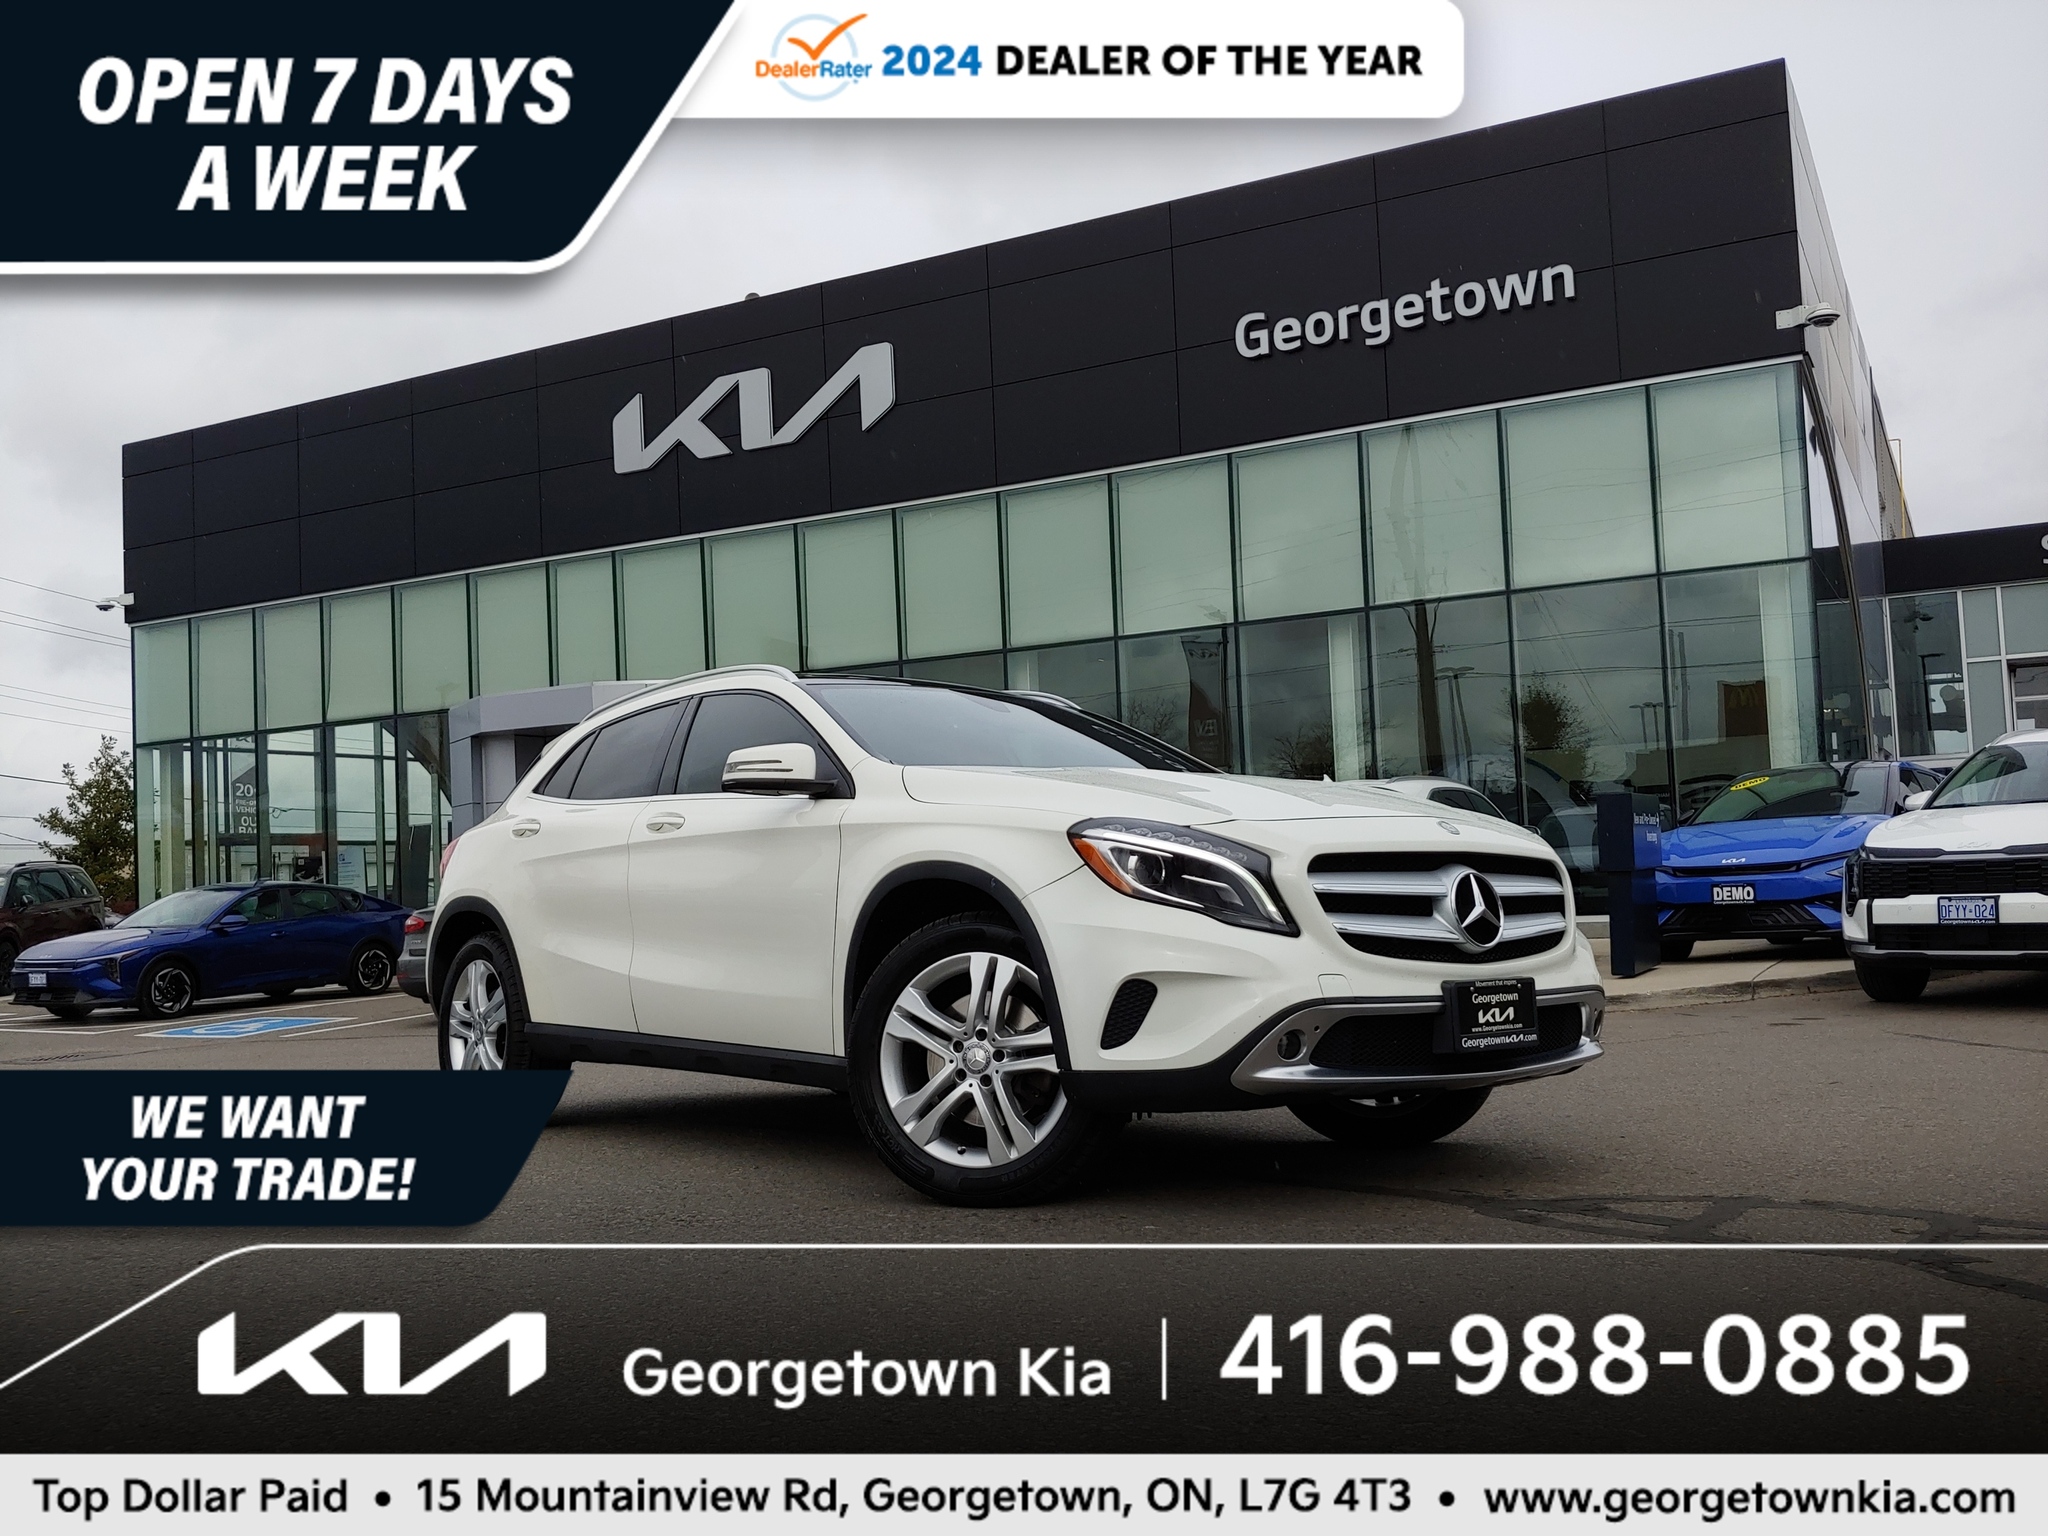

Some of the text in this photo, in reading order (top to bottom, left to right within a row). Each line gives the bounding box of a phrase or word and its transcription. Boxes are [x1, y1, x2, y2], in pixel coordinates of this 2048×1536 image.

[1235, 264, 1576, 358] Georgetown
[1713, 886, 1755, 901] DEMO
[1472, 993, 1519, 1004] Georgetown
